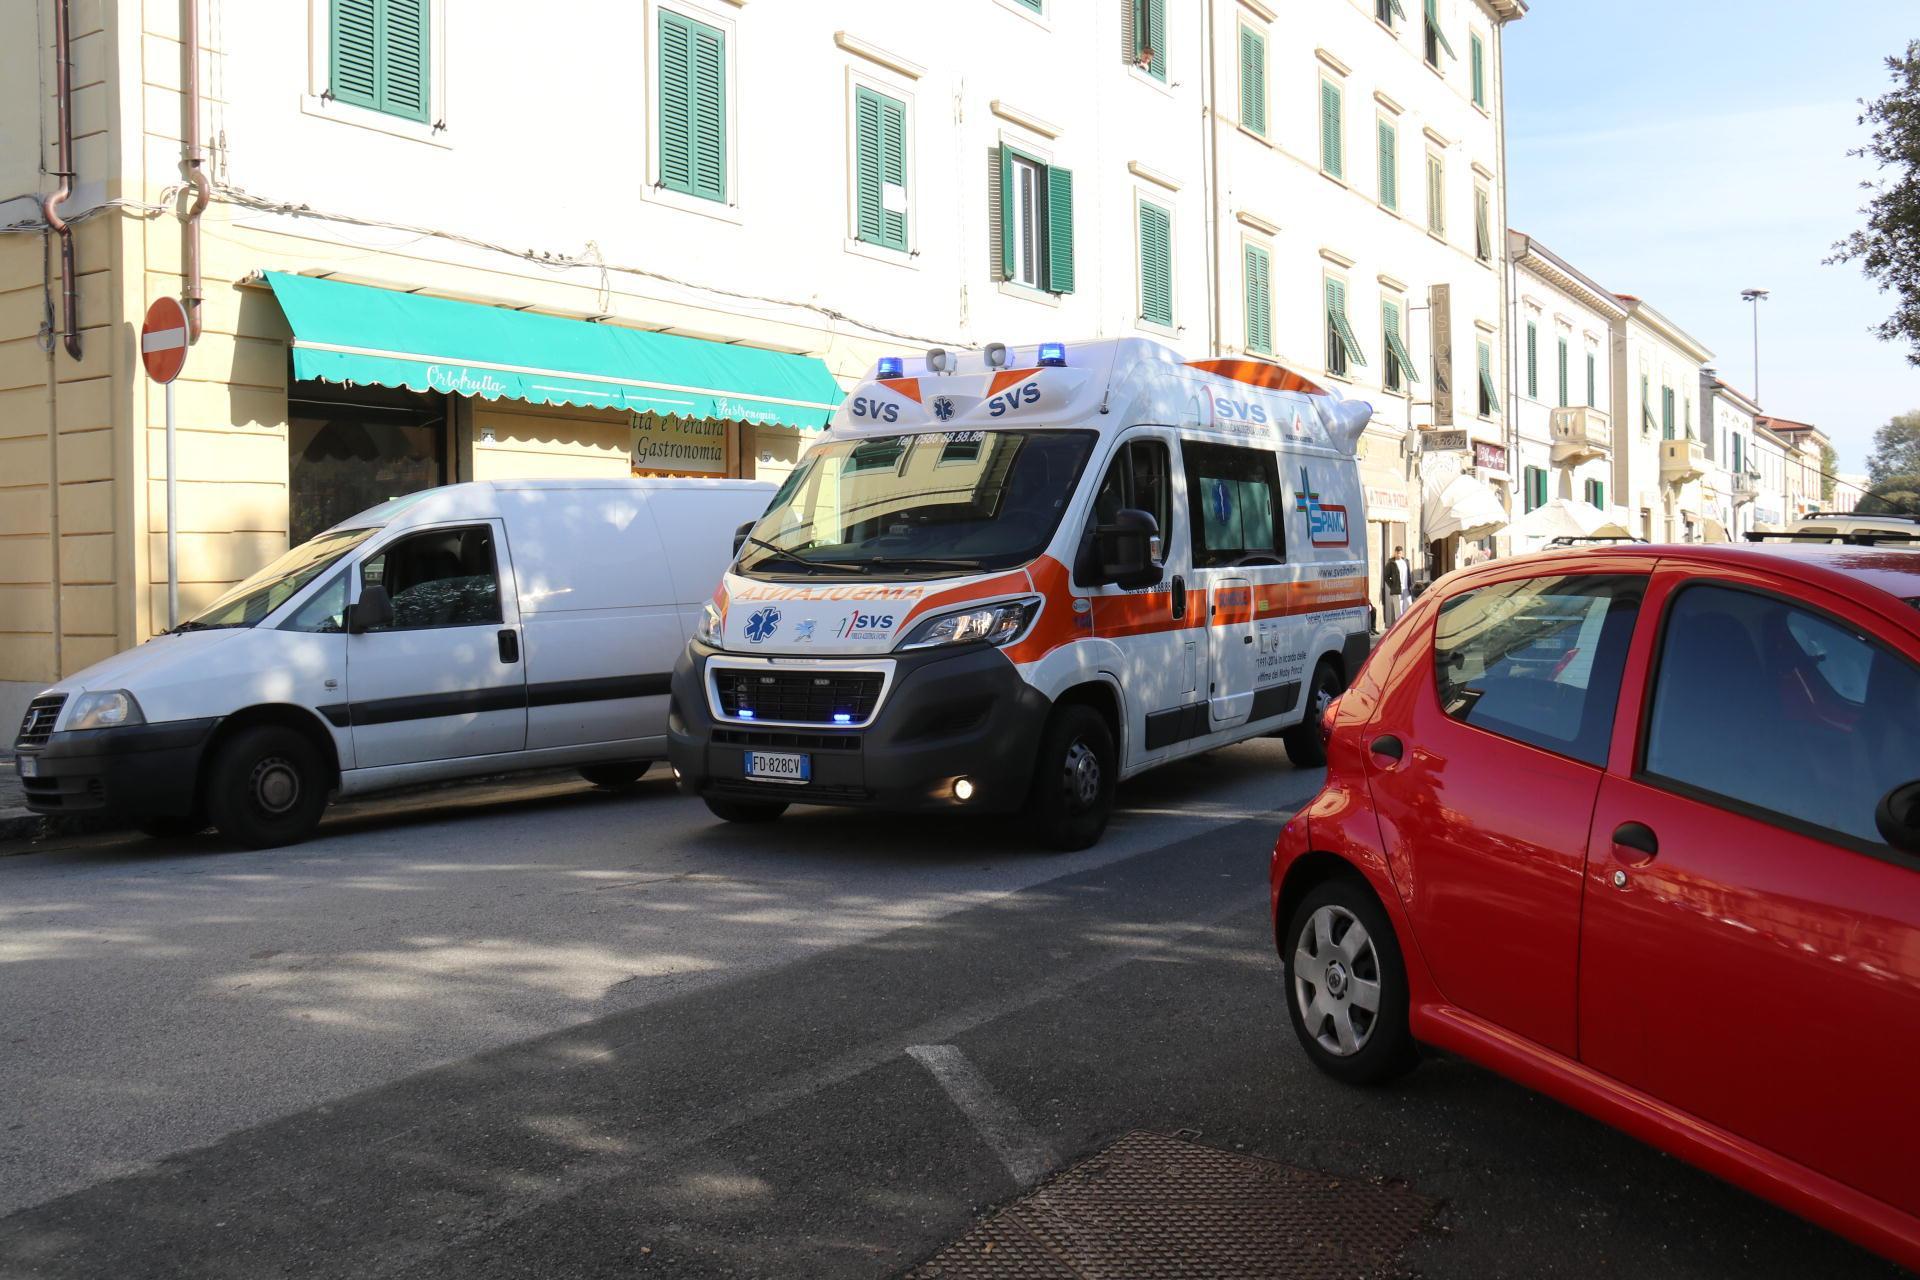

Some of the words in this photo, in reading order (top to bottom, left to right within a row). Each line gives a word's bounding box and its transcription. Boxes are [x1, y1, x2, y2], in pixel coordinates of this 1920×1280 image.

[427, 365, 506, 392] Ortofrutta
[852, 396, 900, 423] SVS
[988, 382, 1041, 417] SVS
[1215, 398, 1267, 423] SVS
[661, 417, 667, 431] e
[941, 431, 985, 443] 88.88.88
[638, 437, 721, 463] Gastronomia
[855, 615, 893, 629] SVS
[753, 756, 766, 771] FD
[769, 757, 800, 773] 828GV
